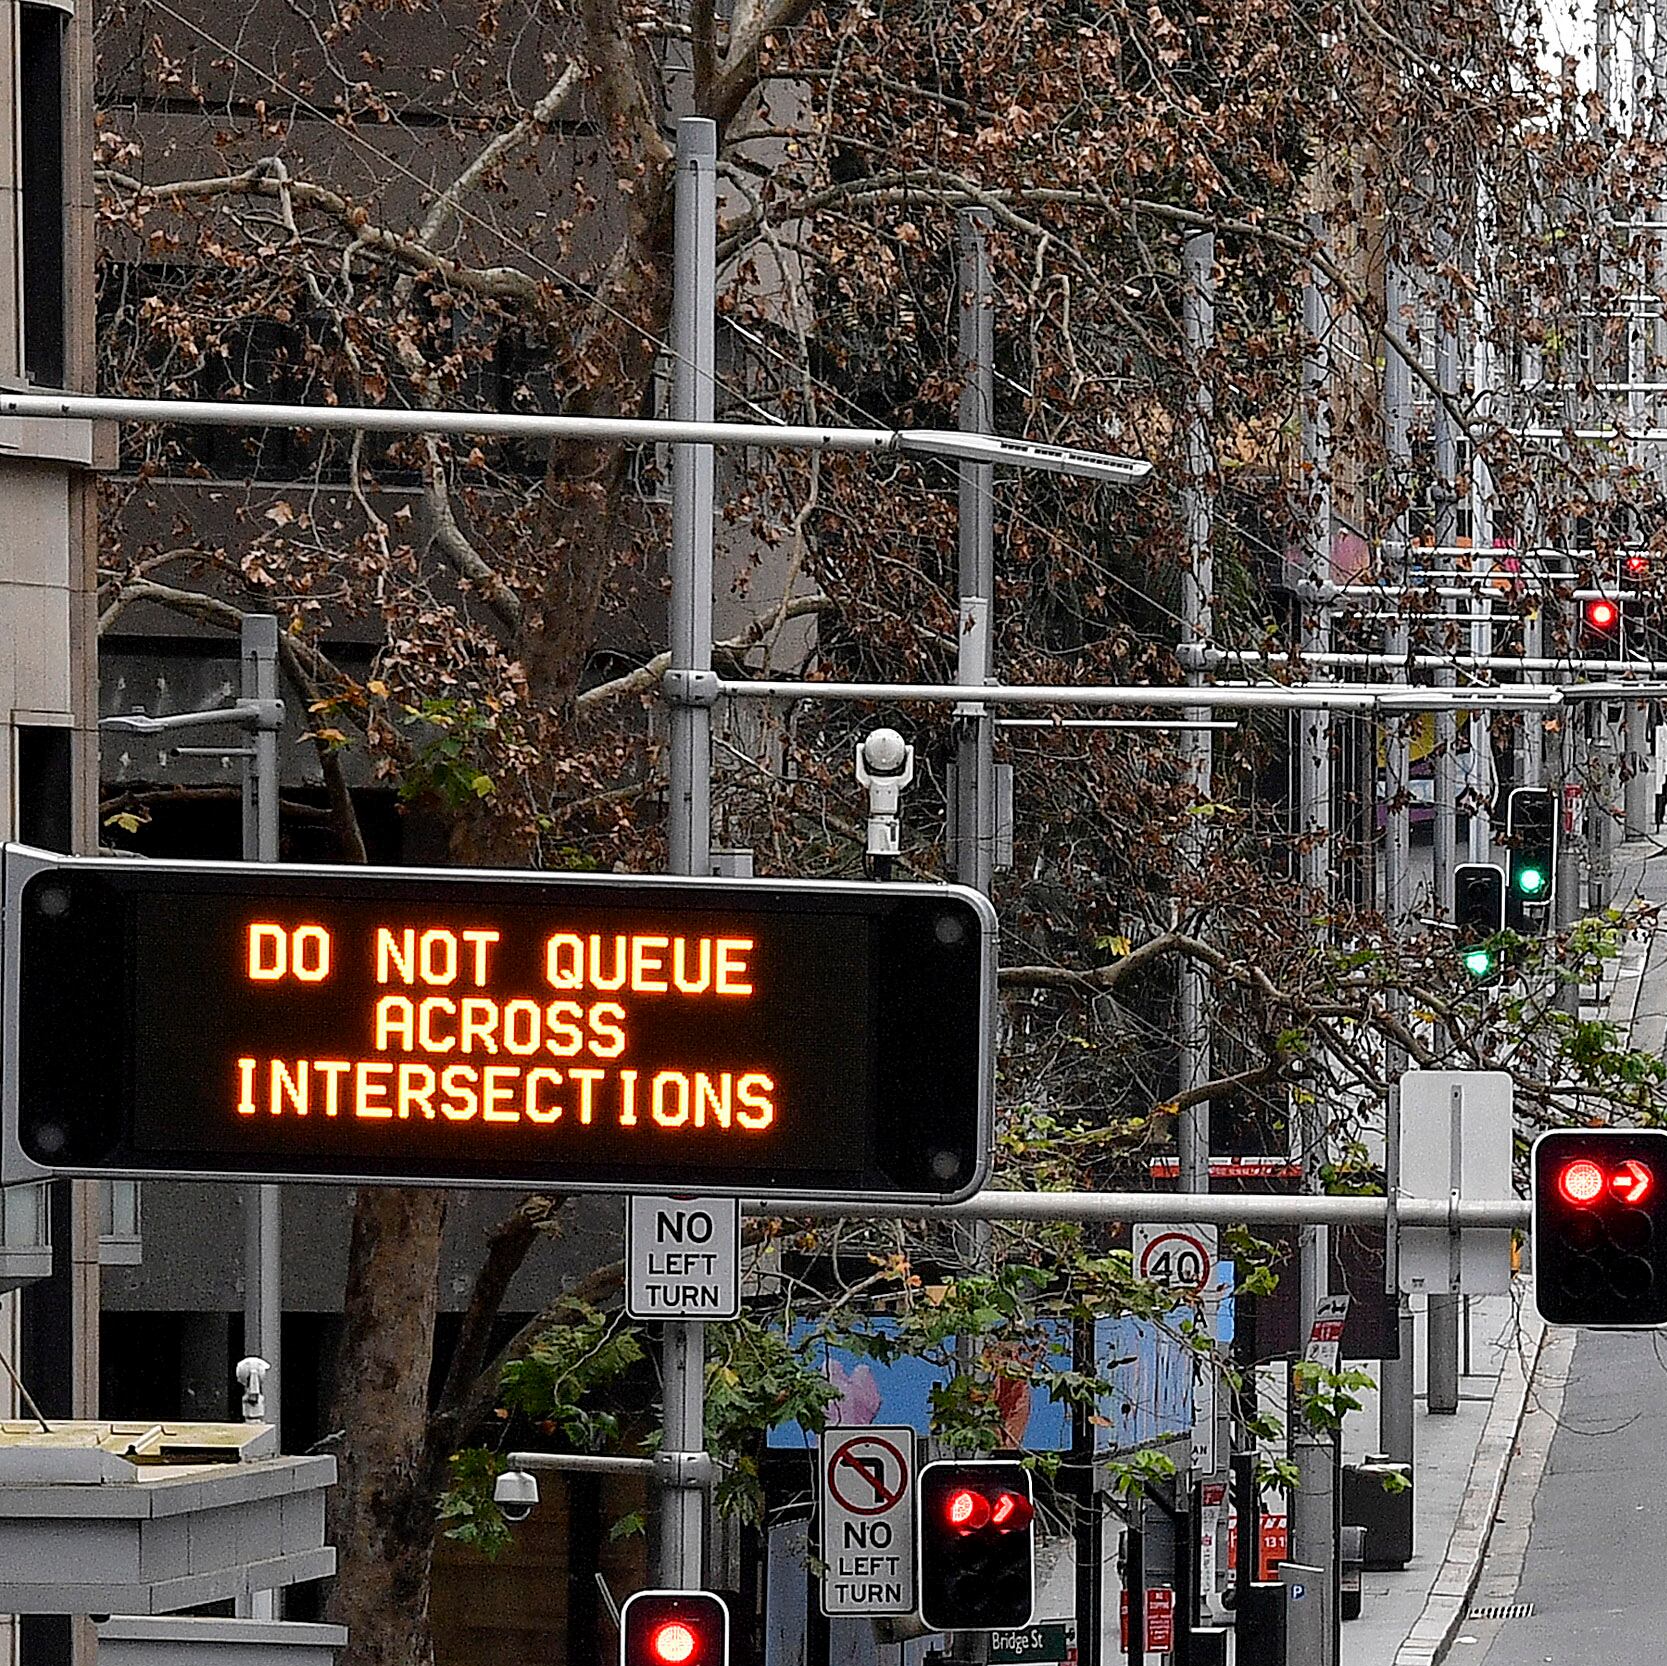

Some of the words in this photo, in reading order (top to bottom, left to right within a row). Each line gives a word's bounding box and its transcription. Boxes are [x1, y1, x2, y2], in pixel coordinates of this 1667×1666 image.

[248, 923, 330, 982] DO
[377, 928, 500, 986] NOT
[546, 932, 754, 995] QUEUE
[375, 996, 626, 1058] ACROSS
[238, 1057, 774, 1129] INTERSECTIONS
[657, 1211, 713, 1244] NO
[648, 1253, 717, 1275] LEFT
[1150, 1251, 1200, 1285] 40
[645, 1285, 718, 1307] TURN
[844, 1521, 892, 1549] NO
[839, 1556, 899, 1575] LEFT
[835, 1584, 901, 1603] TURN
[992, 1631, 1029, 1654] Bridge
[1031, 1629, 1043, 1648] St
